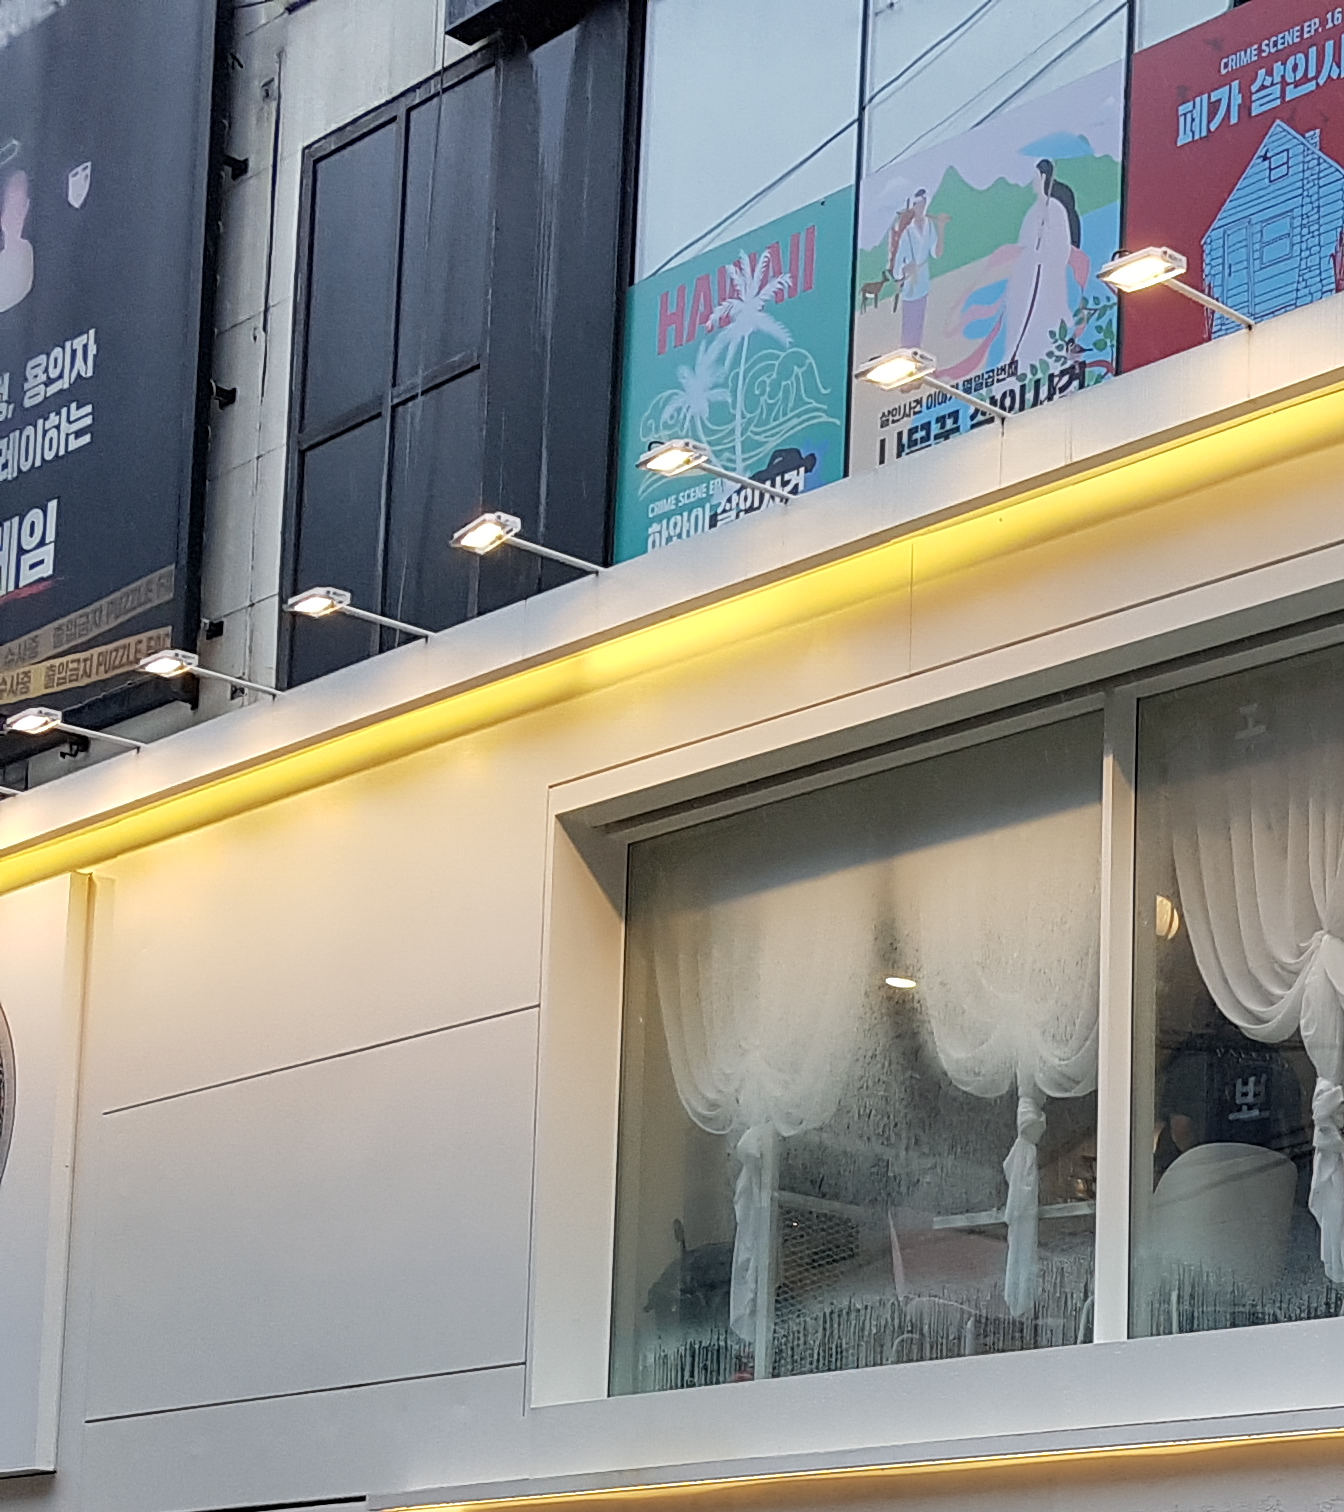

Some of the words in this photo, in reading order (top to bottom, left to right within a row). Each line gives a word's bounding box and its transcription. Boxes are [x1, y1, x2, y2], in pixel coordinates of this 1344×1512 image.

[1220, 44, 1258, 75] CRIME
[1262, 26, 1300, 57] SCENE
[1303, 18, 1322, 39] EP.
[1326, 8, 1343, 29] 16
[1177, 80, 1242, 146] 폐가
[657, 225, 816, 355] HAWAII
[23, 329, 98, 408] 용의자
[880, 401, 922, 428] 살인사건
[648, 499, 676, 518] CRIME
[678, 485, 707, 507] SCENE
[44, 653, 93, 690] 출입금지
[96, 640, 142, 676] PUZZLE
